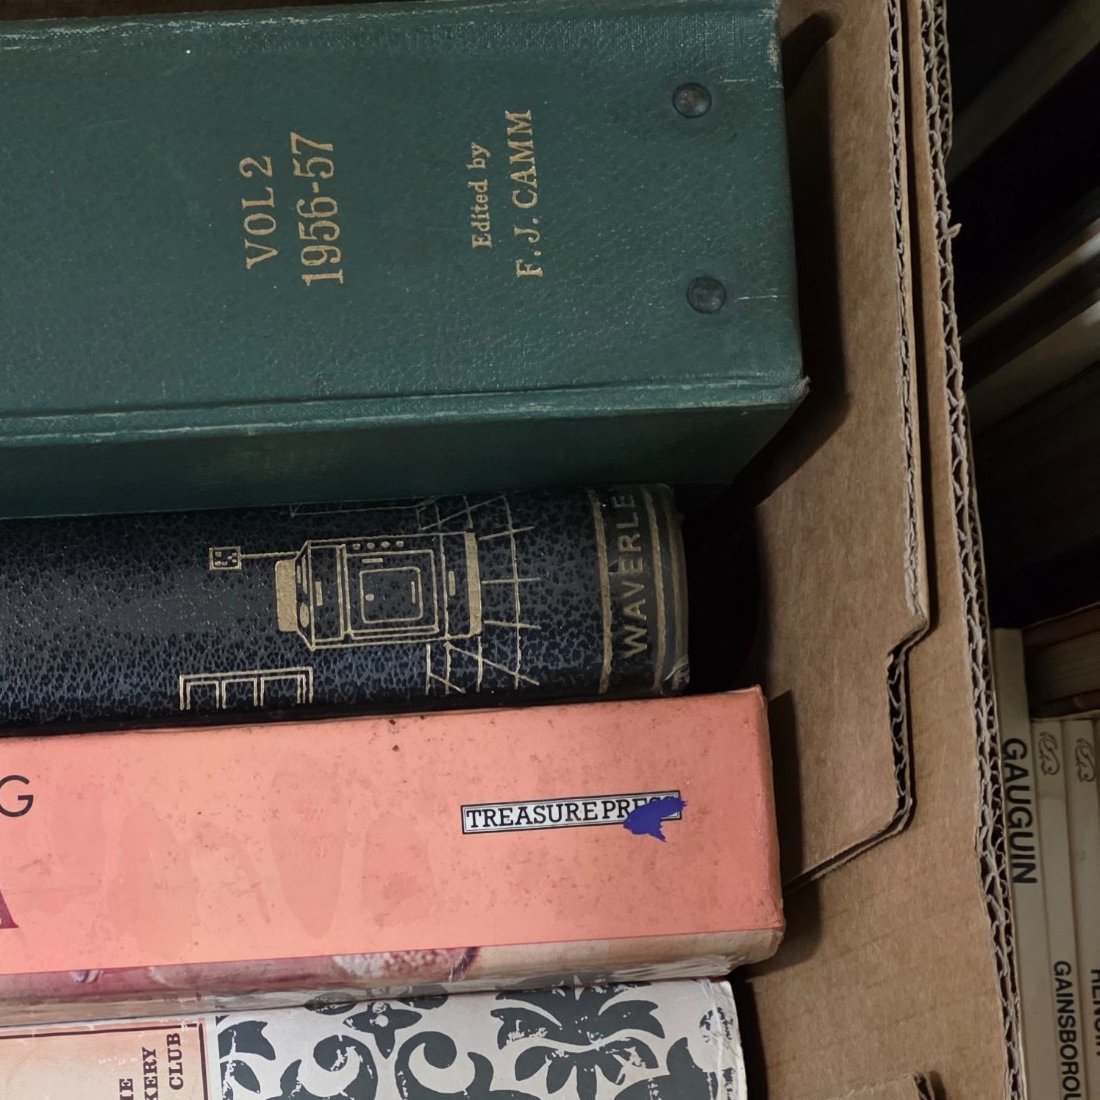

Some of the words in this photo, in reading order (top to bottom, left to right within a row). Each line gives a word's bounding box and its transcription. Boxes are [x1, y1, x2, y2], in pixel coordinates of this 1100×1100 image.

[239, 154, 274, 179] 2
[466, 142, 492, 170] by
[504, 109, 539, 210] CAMM
[242, 186, 279, 270] VOL
[290, 131, 345, 287] 1956-57
[467, 178, 493, 250] Edited
[611, 493, 648, 659] WAVERLE
[465, 800, 599, 829] TREASURE
[1002, 736, 1038, 885] GAUGUIN
[166, 1032, 185, 1091] CLUB
